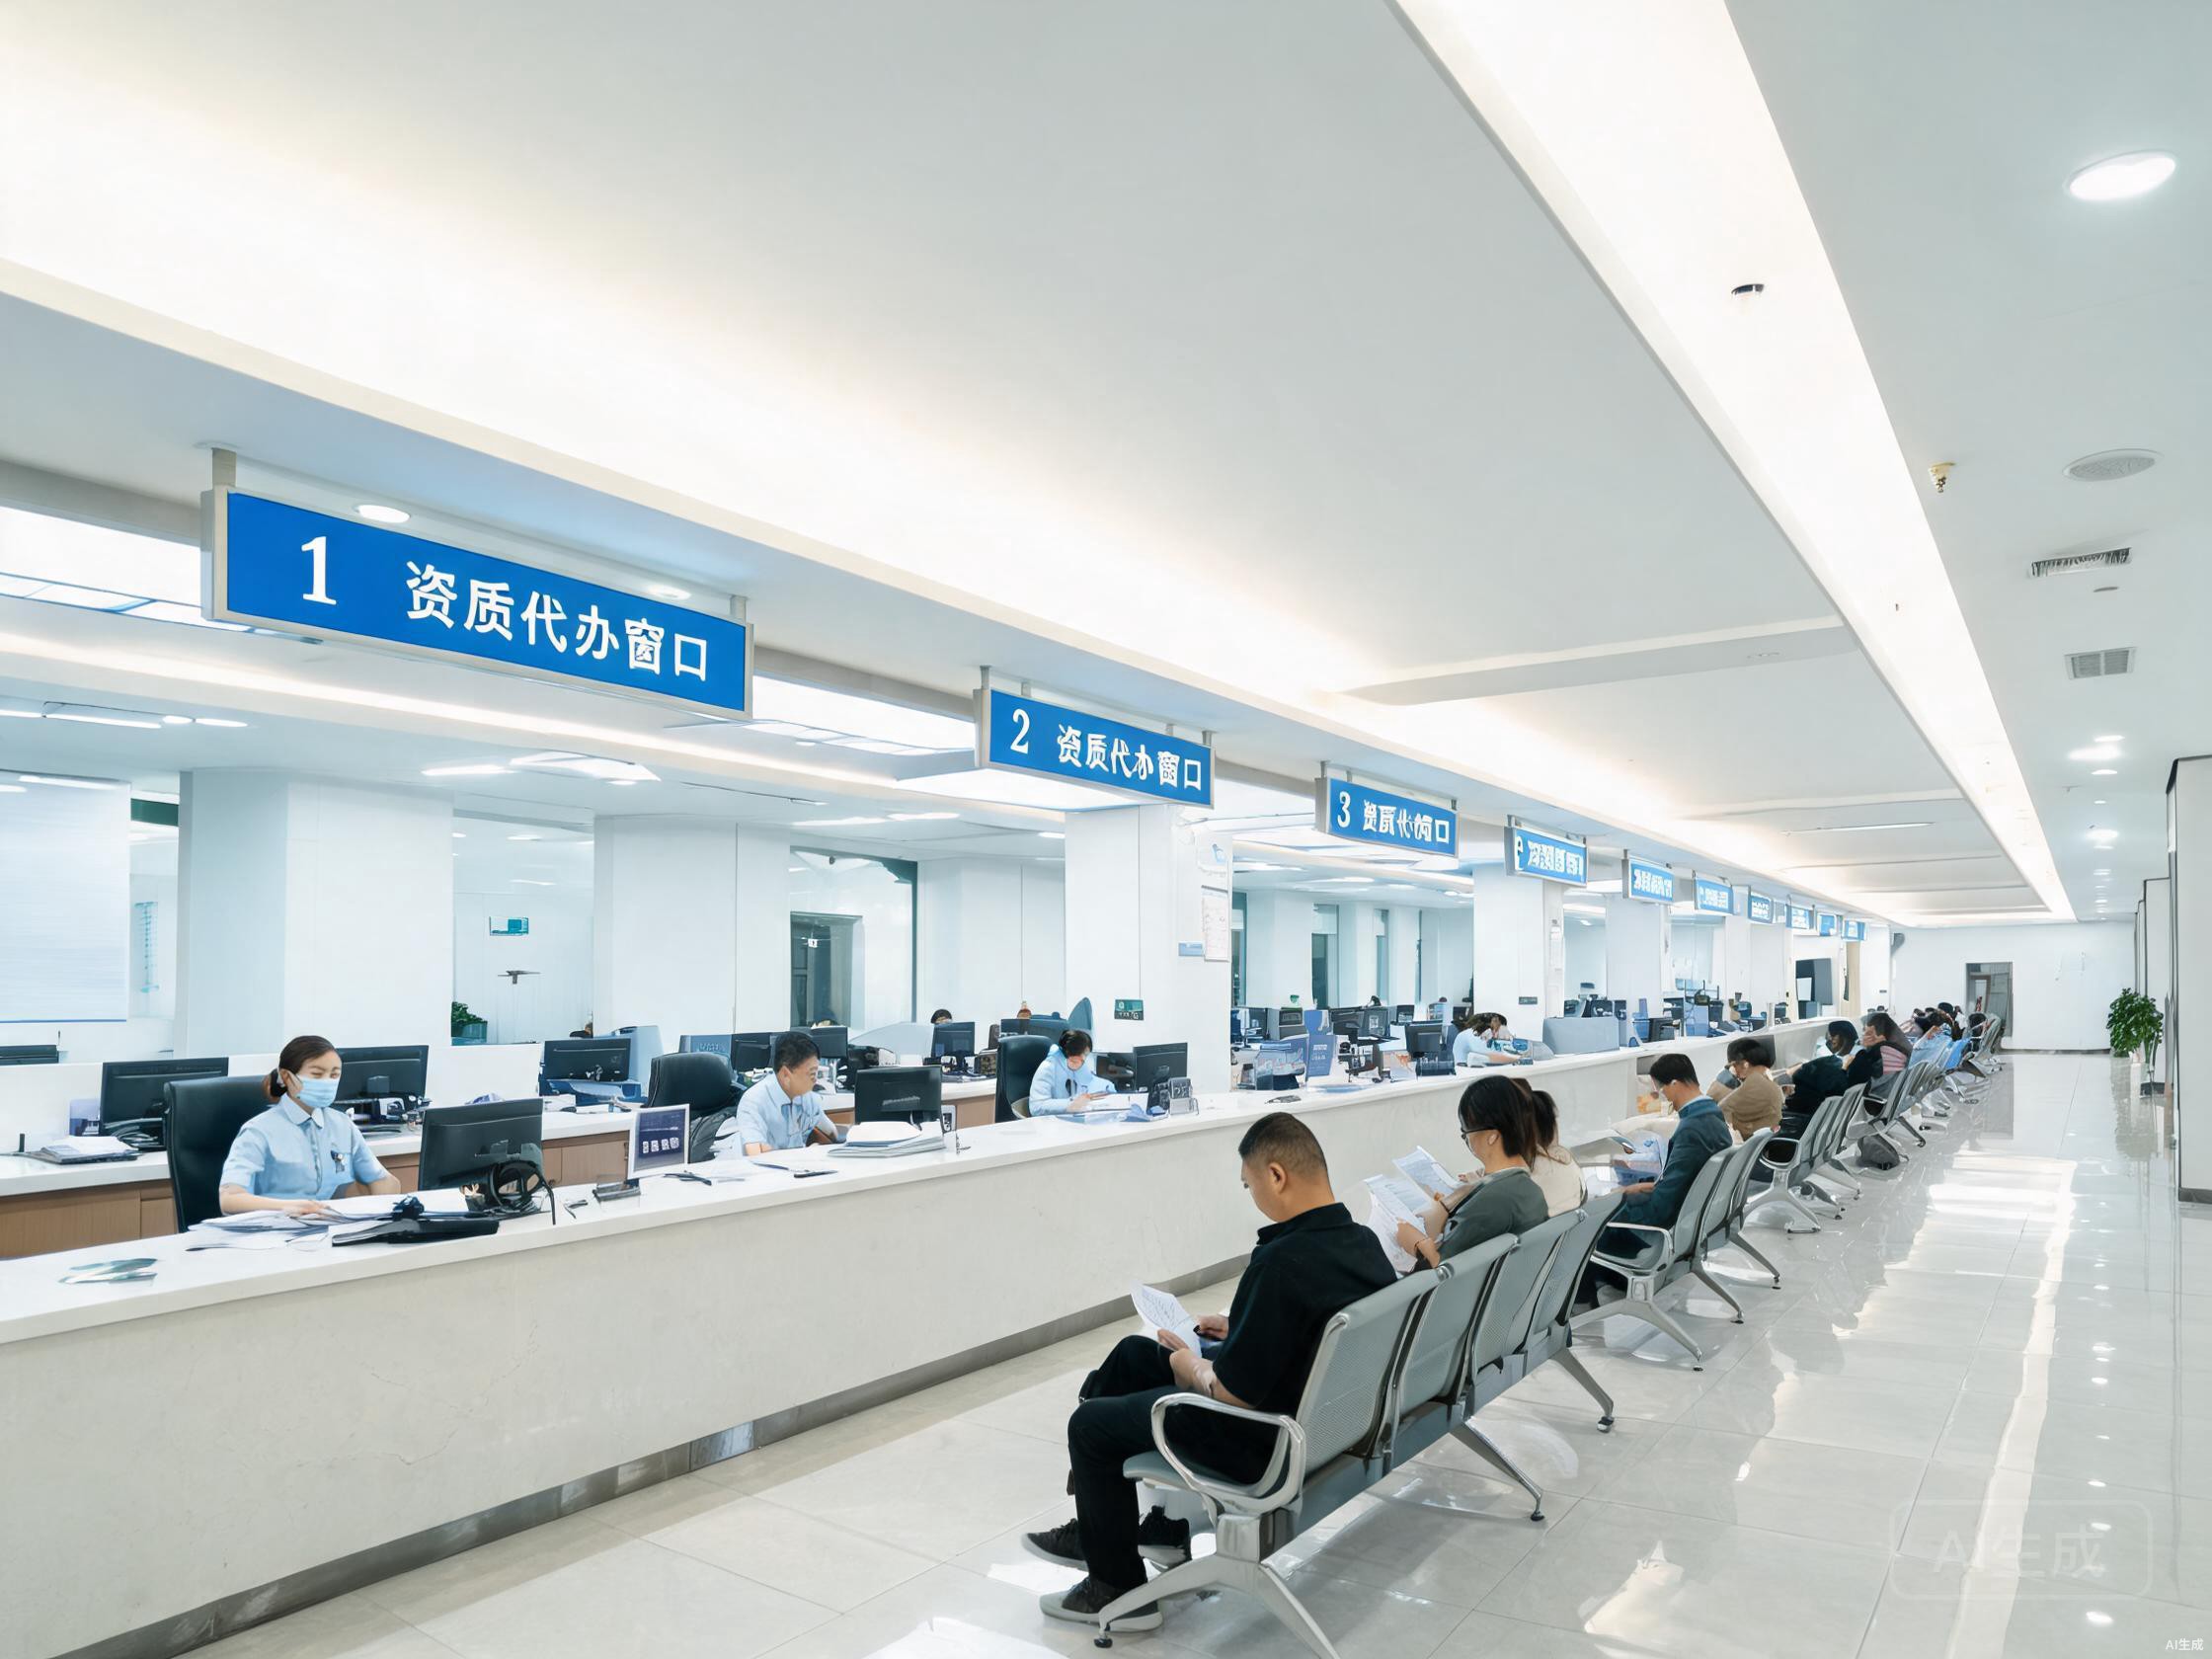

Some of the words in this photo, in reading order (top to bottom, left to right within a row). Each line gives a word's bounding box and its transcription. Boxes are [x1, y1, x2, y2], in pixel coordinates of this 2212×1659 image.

[301, 536, 337, 605] 1
[407, 561, 707, 680] 资质代办窗口
[1010, 708, 1030, 754] 2
[1337, 791, 1351, 829] 3
